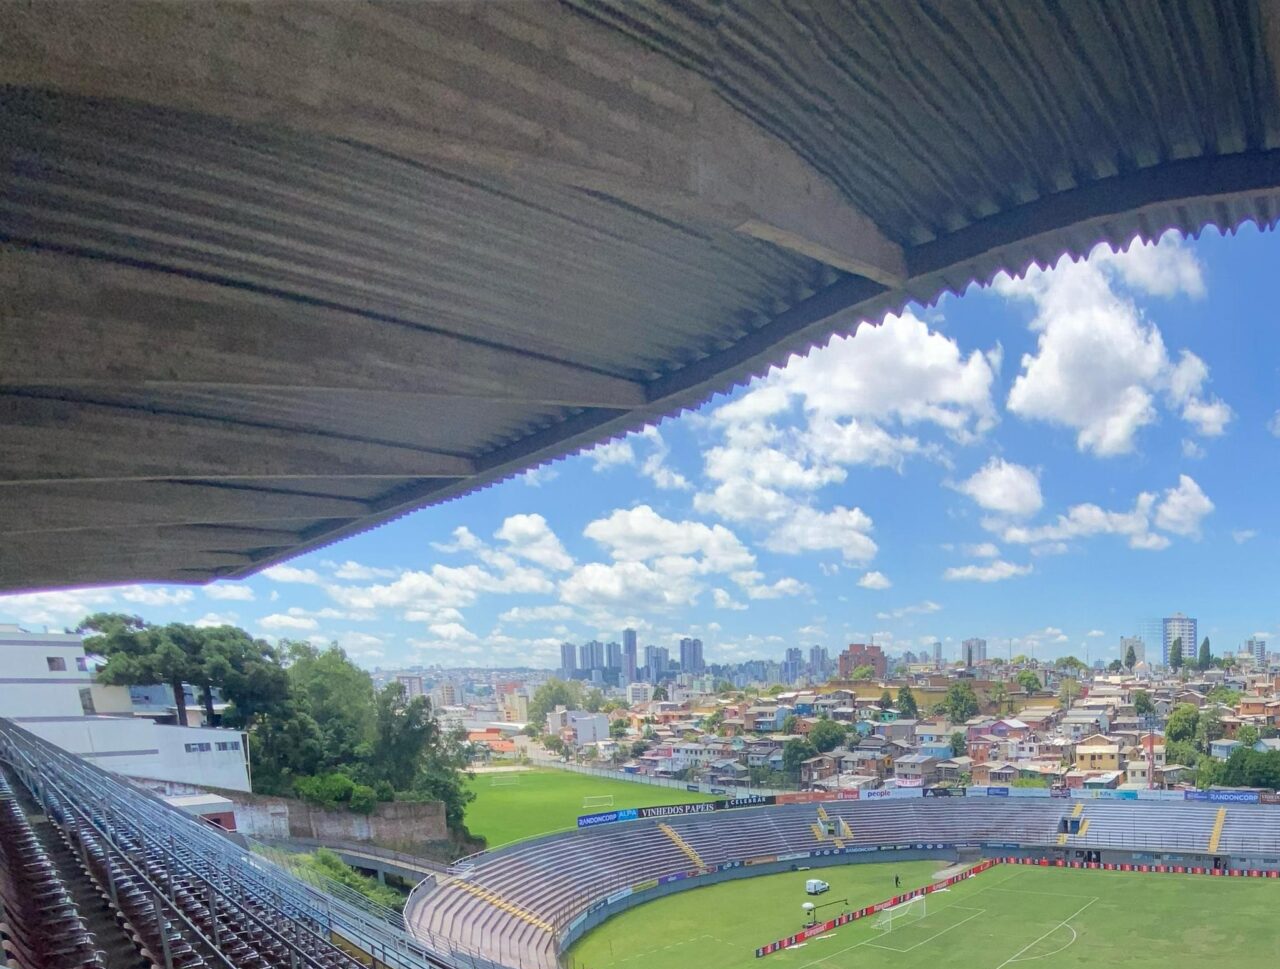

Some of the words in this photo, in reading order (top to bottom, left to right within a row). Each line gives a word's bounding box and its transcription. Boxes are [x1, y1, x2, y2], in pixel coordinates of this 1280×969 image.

[867, 790, 892, 798] people
[1209, 793, 1259, 801] RANDONCORP
[642, 805, 684, 818] VINHEDOS
[685, 802, 715, 815] PAPÉIS
